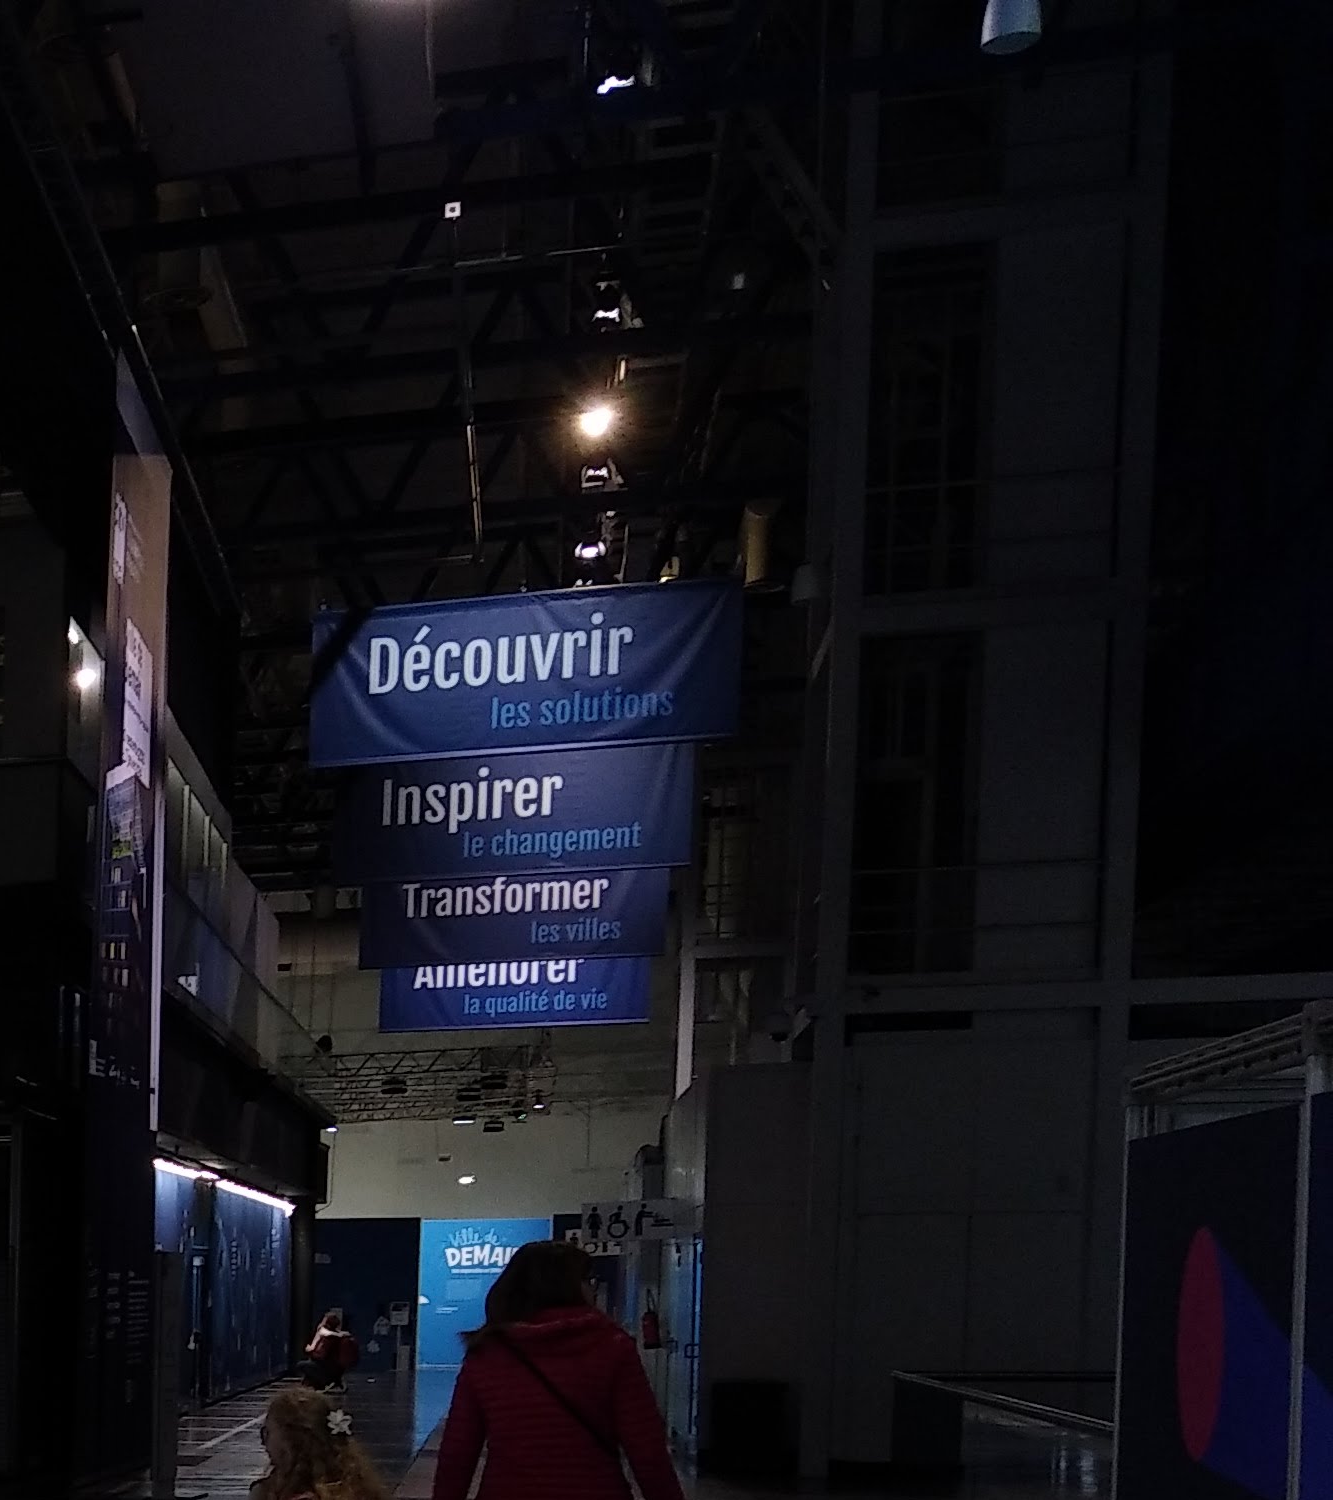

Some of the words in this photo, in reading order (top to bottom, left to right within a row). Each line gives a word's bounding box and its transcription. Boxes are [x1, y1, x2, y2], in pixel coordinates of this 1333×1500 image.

[369, 612, 633, 694] Découvrir
[491, 696, 529, 729] les
[540, 687, 673, 726] solutions
[382, 767, 564, 835] Inspirer
[464, 832, 483, 857] le
[491, 822, 641, 860] changement
[403, 876, 609, 917] Transformer
[532, 921, 560, 944] les
[566, 918, 620, 941] villes
[463, 994, 481, 1014] la
[485, 989, 548, 1017] qualité
[553, 990, 575, 1010] de
[581, 988, 607, 1010] vie
